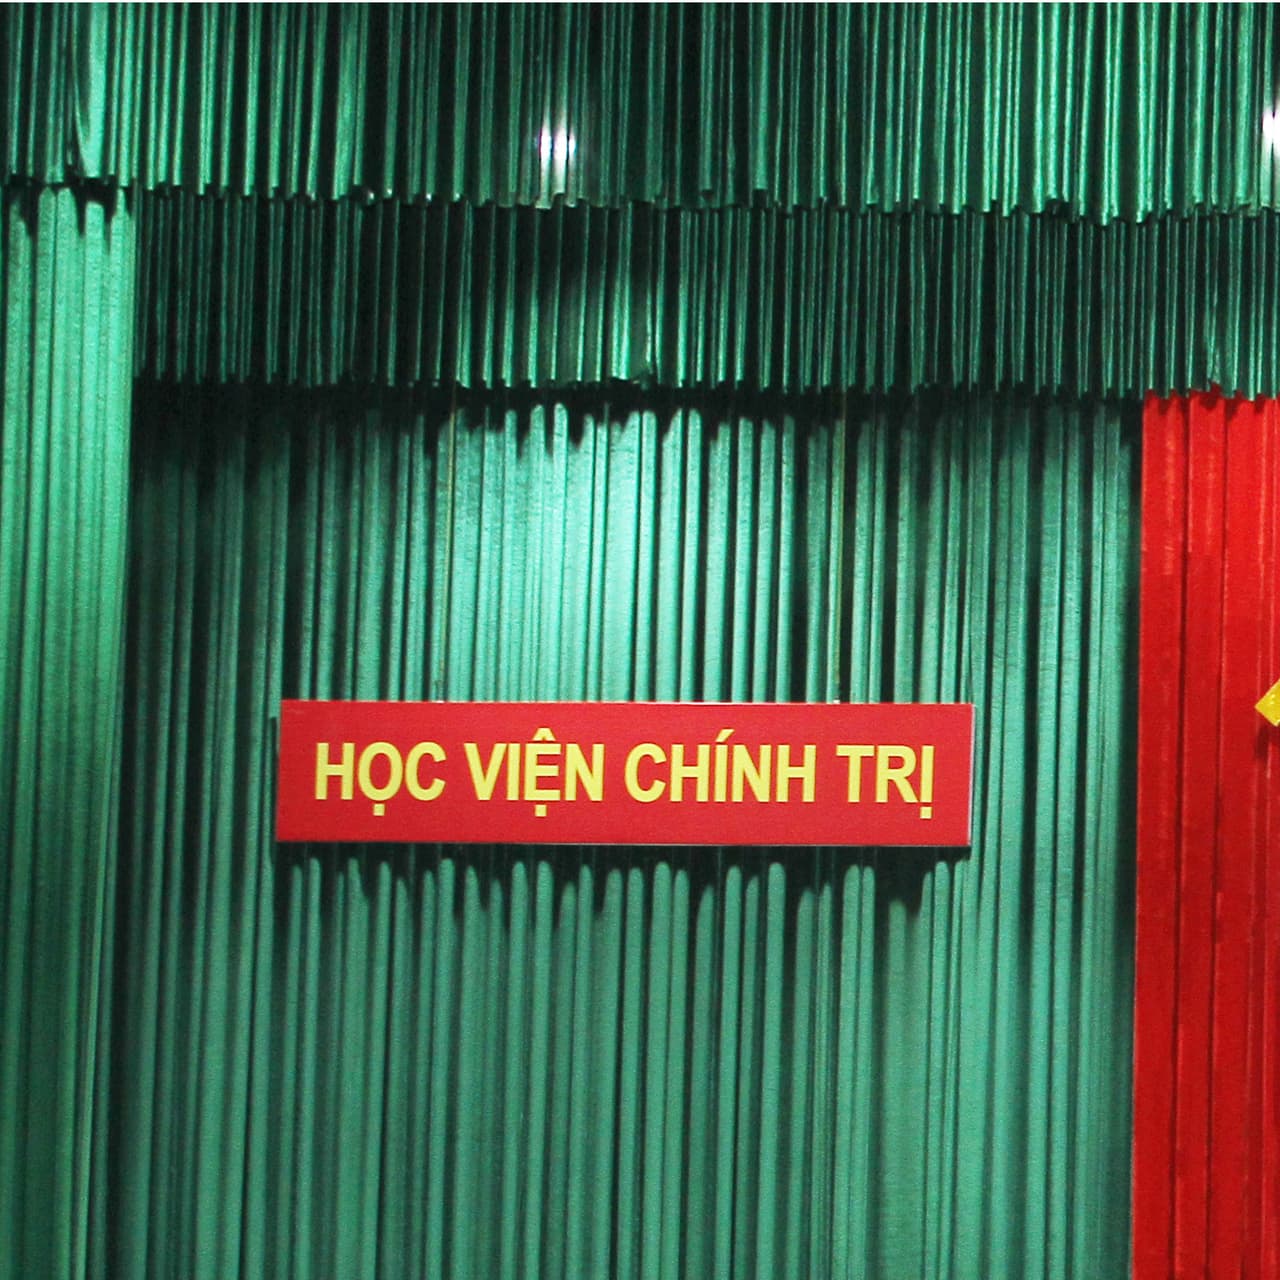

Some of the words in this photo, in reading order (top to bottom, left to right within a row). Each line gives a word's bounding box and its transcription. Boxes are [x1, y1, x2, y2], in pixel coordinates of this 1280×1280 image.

[315, 742, 446, 816] HỌC
[464, 728, 605, 816] VIỆN
[625, 729, 816, 802] CHÍNH
[836, 745, 934, 819] TRỊ
